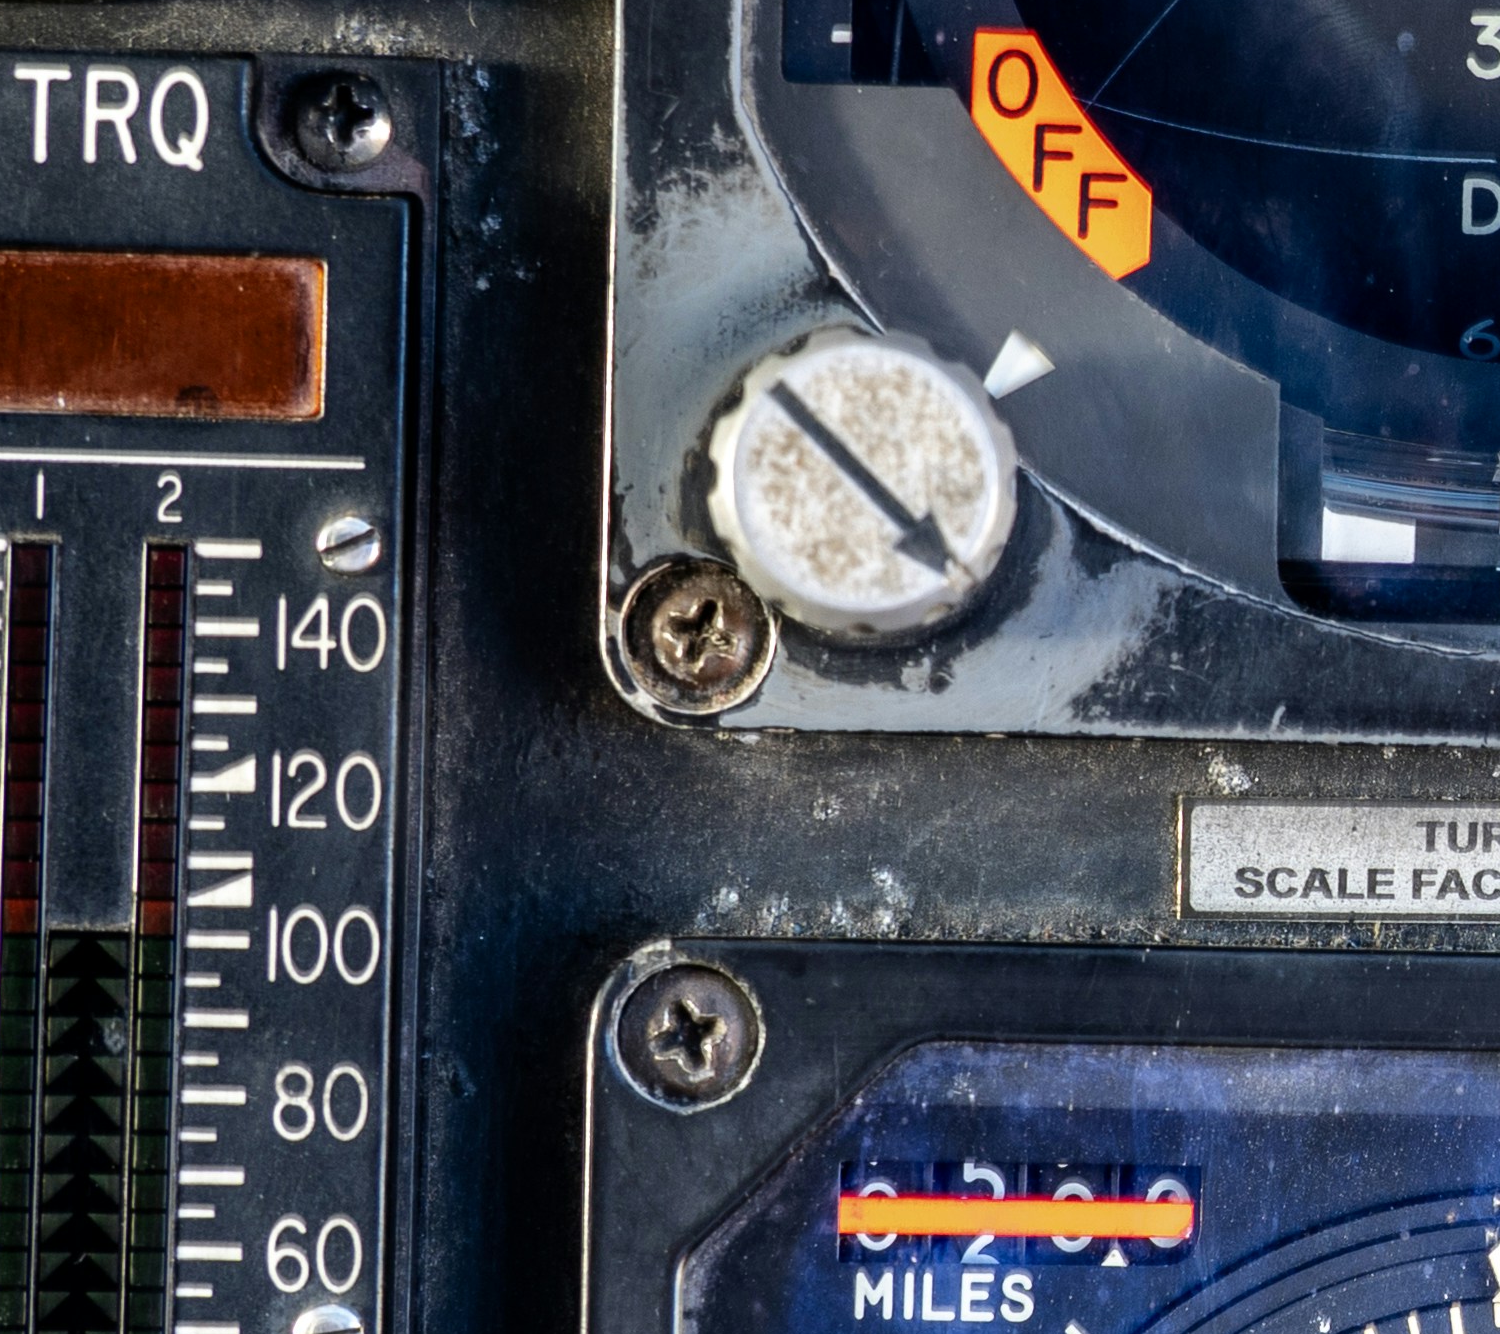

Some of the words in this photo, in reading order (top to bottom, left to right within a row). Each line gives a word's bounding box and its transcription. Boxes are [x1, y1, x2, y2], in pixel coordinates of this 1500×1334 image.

[15, 70, 211, 173] TRQ
[988, 48, 1129, 240] OFF
[157, 473, 183, 522] 2
[278, 595, 386, 672] 140
[272, 749, 381, 831] 120
[1234, 867, 1396, 902] SCALE
[268, 906, 380, 985] 100
[273, 1062, 369, 1141] 80
[266, 1215, 363, 1295] 60
[854, 1271, 1035, 1323] MILES
